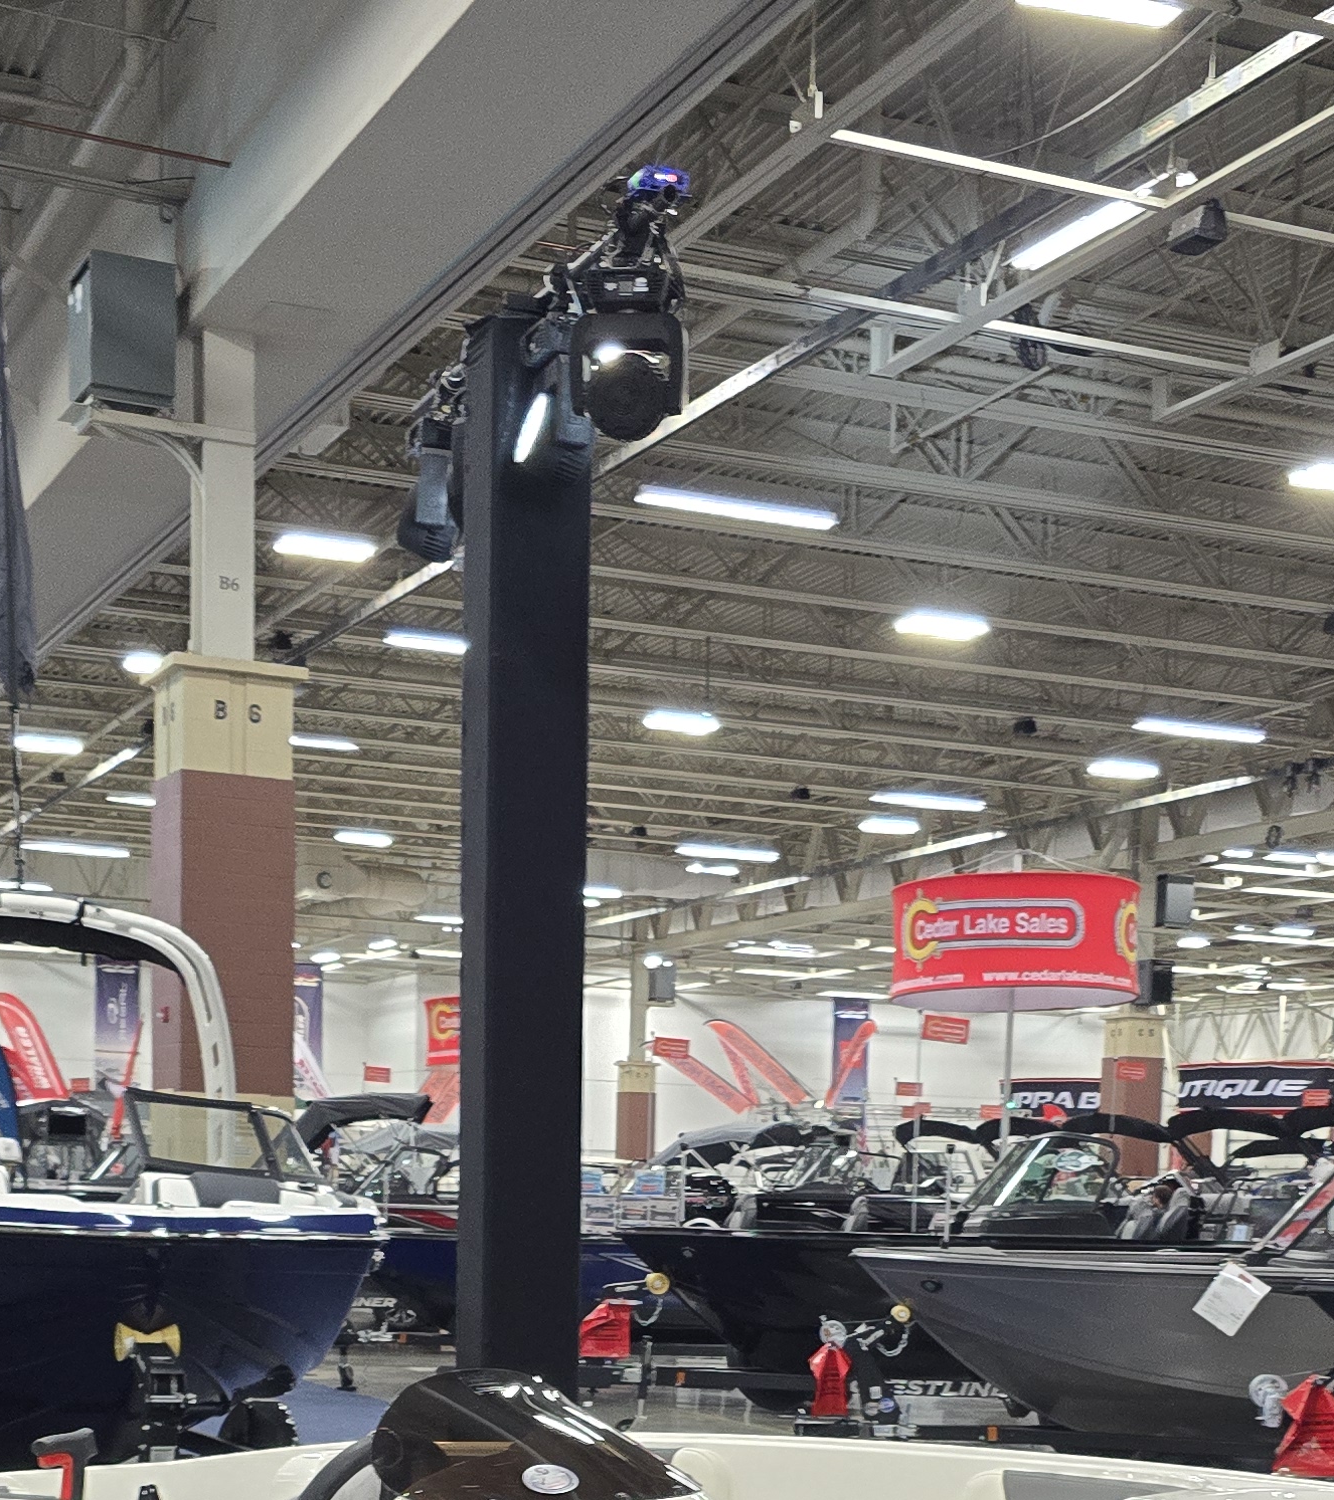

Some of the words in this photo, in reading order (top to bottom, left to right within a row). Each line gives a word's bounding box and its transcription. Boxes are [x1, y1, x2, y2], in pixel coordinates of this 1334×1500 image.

[218, 575, 240, 592] B6
[915, 918, 960, 940] Cedar
[963, 913, 1011, 935] Lake
[1014, 911, 1069, 934] Sales
